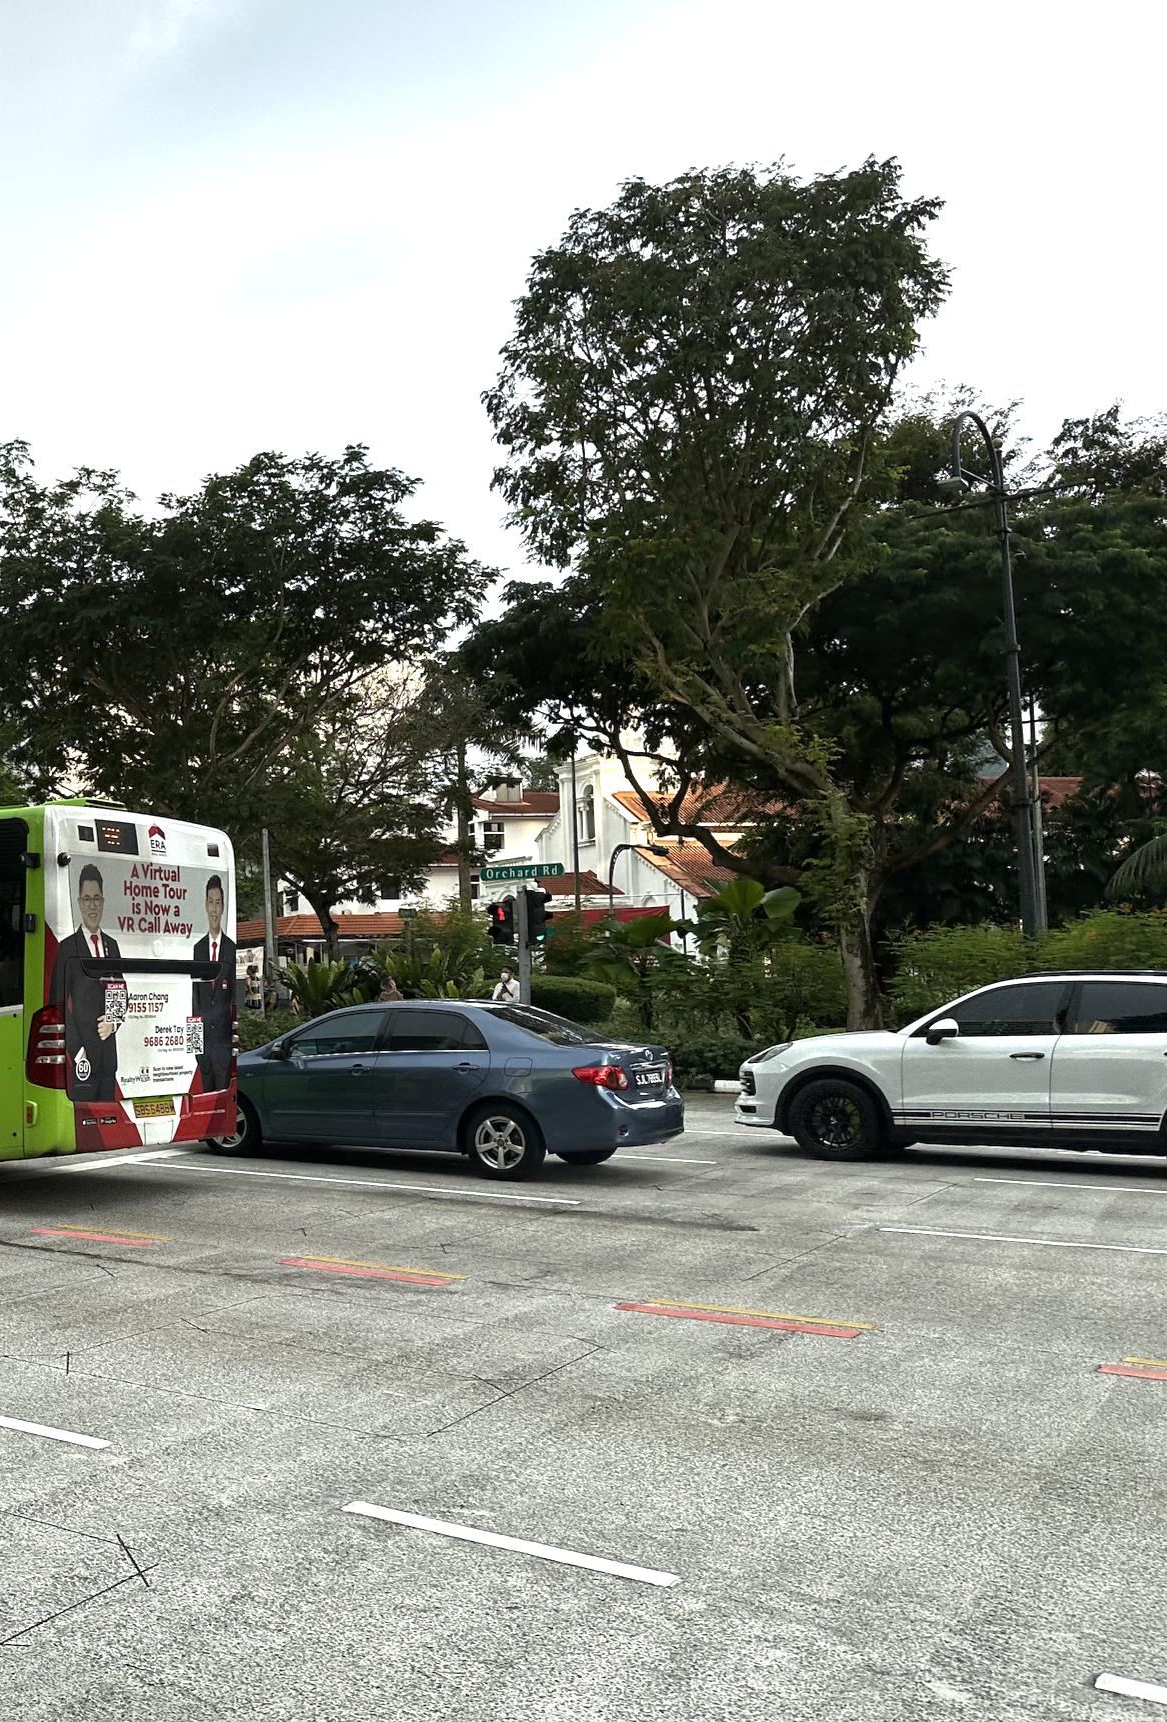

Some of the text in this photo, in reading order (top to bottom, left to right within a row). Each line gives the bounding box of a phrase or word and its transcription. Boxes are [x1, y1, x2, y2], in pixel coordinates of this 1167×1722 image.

[150, 840, 167, 850] ERA
[131, 862, 180, 882] A Virtual
[486, 865, 558, 879] Orchard Rd
[123, 880, 187, 900] Home Tour
[132, 896, 180, 917] is Now a
[117, 916, 193, 939] VR Call Away
[129, 992, 169, 1003] Aaron Chang
[128, 1002, 164, 1013] 9155 1157
[155, 1025, 184, 1036] Derek Tay
[144, 1035, 184, 1047] 9686 2680
[78, 1062, 89, 1073] 60
[931, 1111, 1025, 1120] PORSCHE
